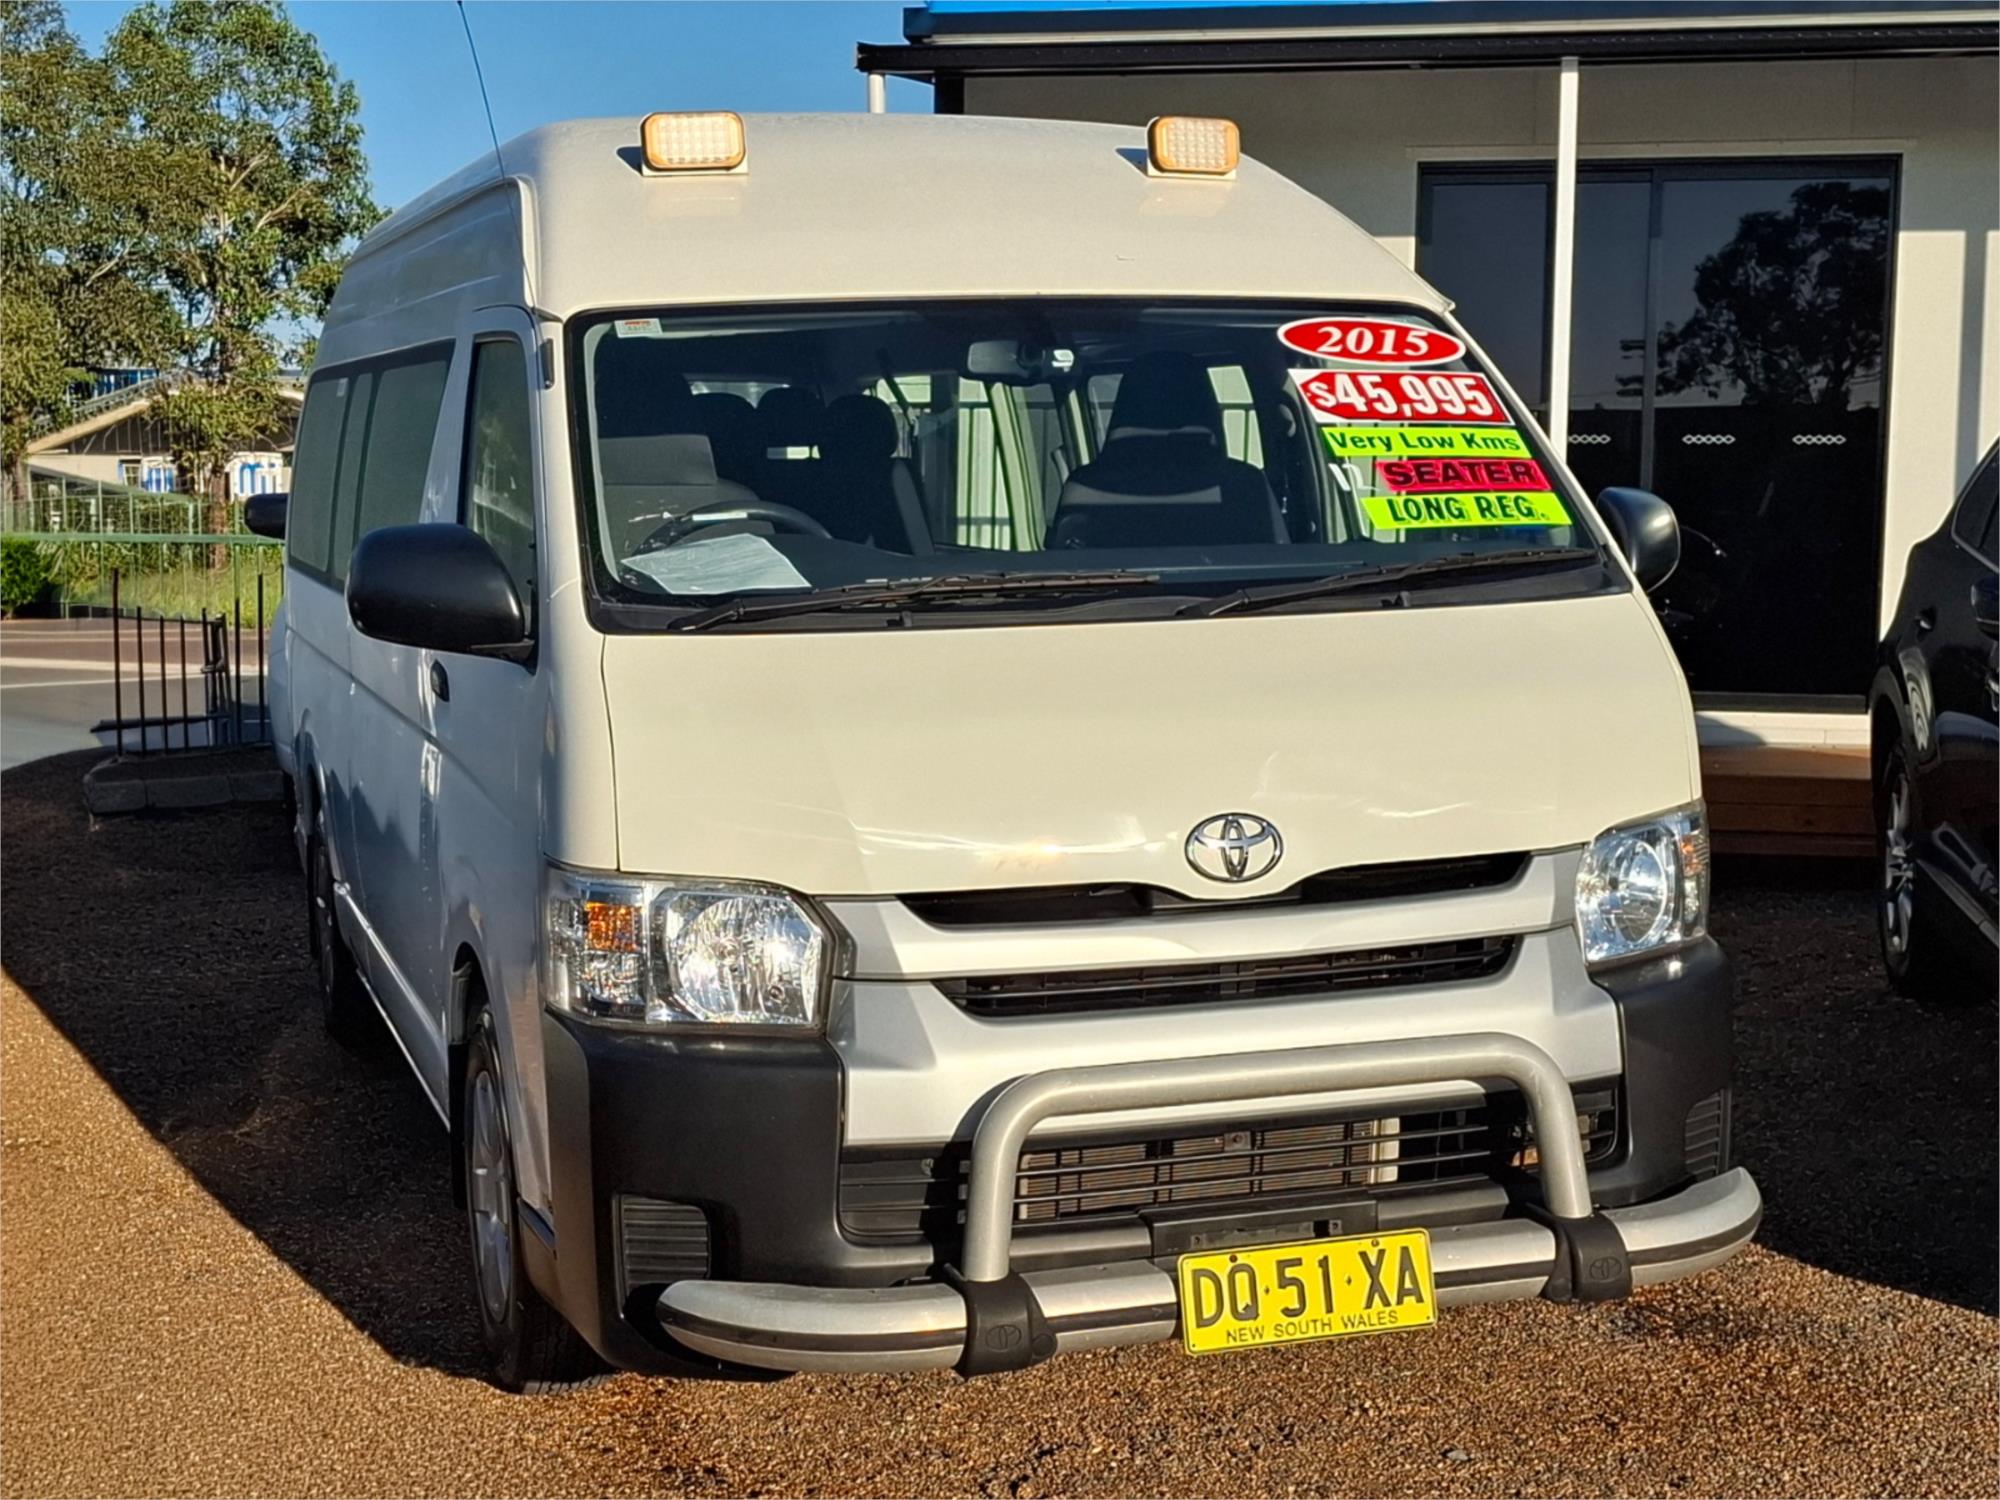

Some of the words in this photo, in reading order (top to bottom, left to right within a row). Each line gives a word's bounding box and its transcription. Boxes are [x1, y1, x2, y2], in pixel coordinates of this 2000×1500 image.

[1316, 326, 1429, 356] 2015
[1307, 372, 1494, 417] $45,995
[1328, 431, 1393, 451] Very
[1400, 432, 1455, 449] Low
[1462, 433, 1521, 451] Kms
[1383, 463, 1538, 486] SEATER
[1386, 497, 1464, 522] LONG
[1474, 496, 1547, 520] REG.
[1226, 1326, 1265, 1344] NEW
[1274, 1317, 1333, 1338] SOUTH
[1341, 1310, 1398, 1329] WALES
